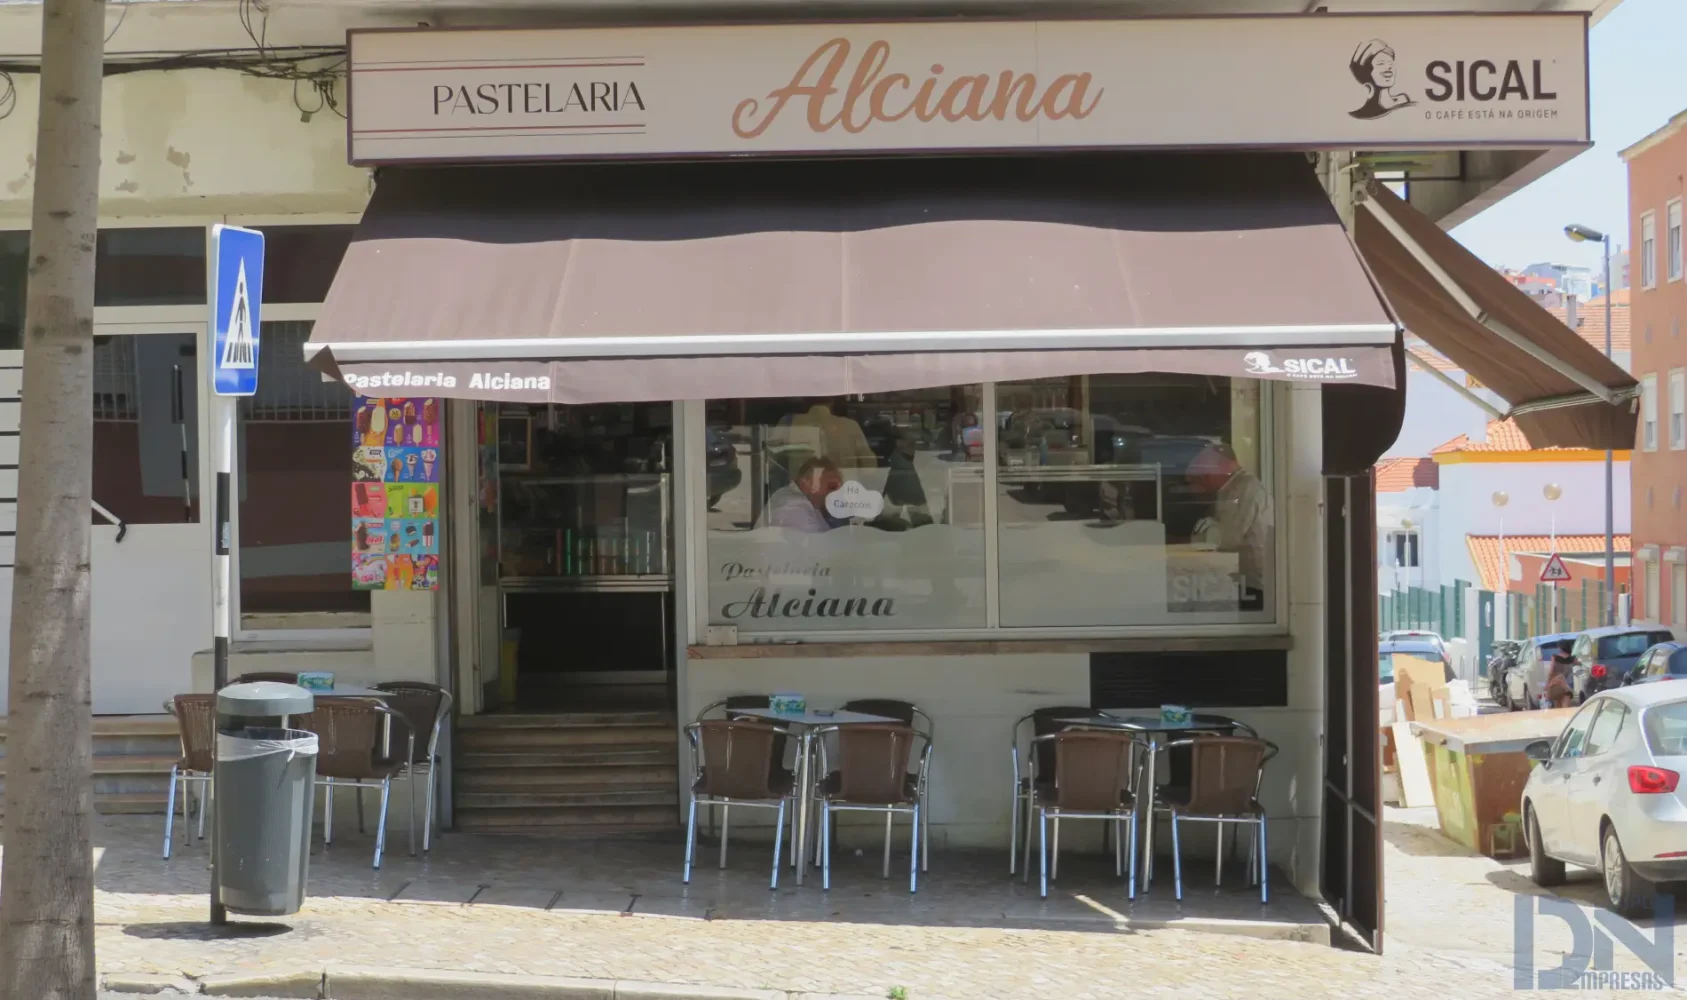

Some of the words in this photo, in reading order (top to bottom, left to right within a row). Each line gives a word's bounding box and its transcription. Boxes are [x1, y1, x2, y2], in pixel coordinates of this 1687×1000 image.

[731, 37, 1104, 139] Alciana
[1425, 59, 1557, 102] SICAL
[433, 81, 646, 116] PASTELARIA
[1425, 111, 1432, 120] O
[1436, 108, 1464, 120] CAFÉ
[1468, 108, 1495, 120] ESTÁ
[1499, 109, 1513, 119] NA
[1517, 108, 1558, 119] ORIGEM
[469, 372, 551, 390] Alciana
[1284, 358, 1356, 374] SICAL
[721, 587, 898, 619] Alciana
